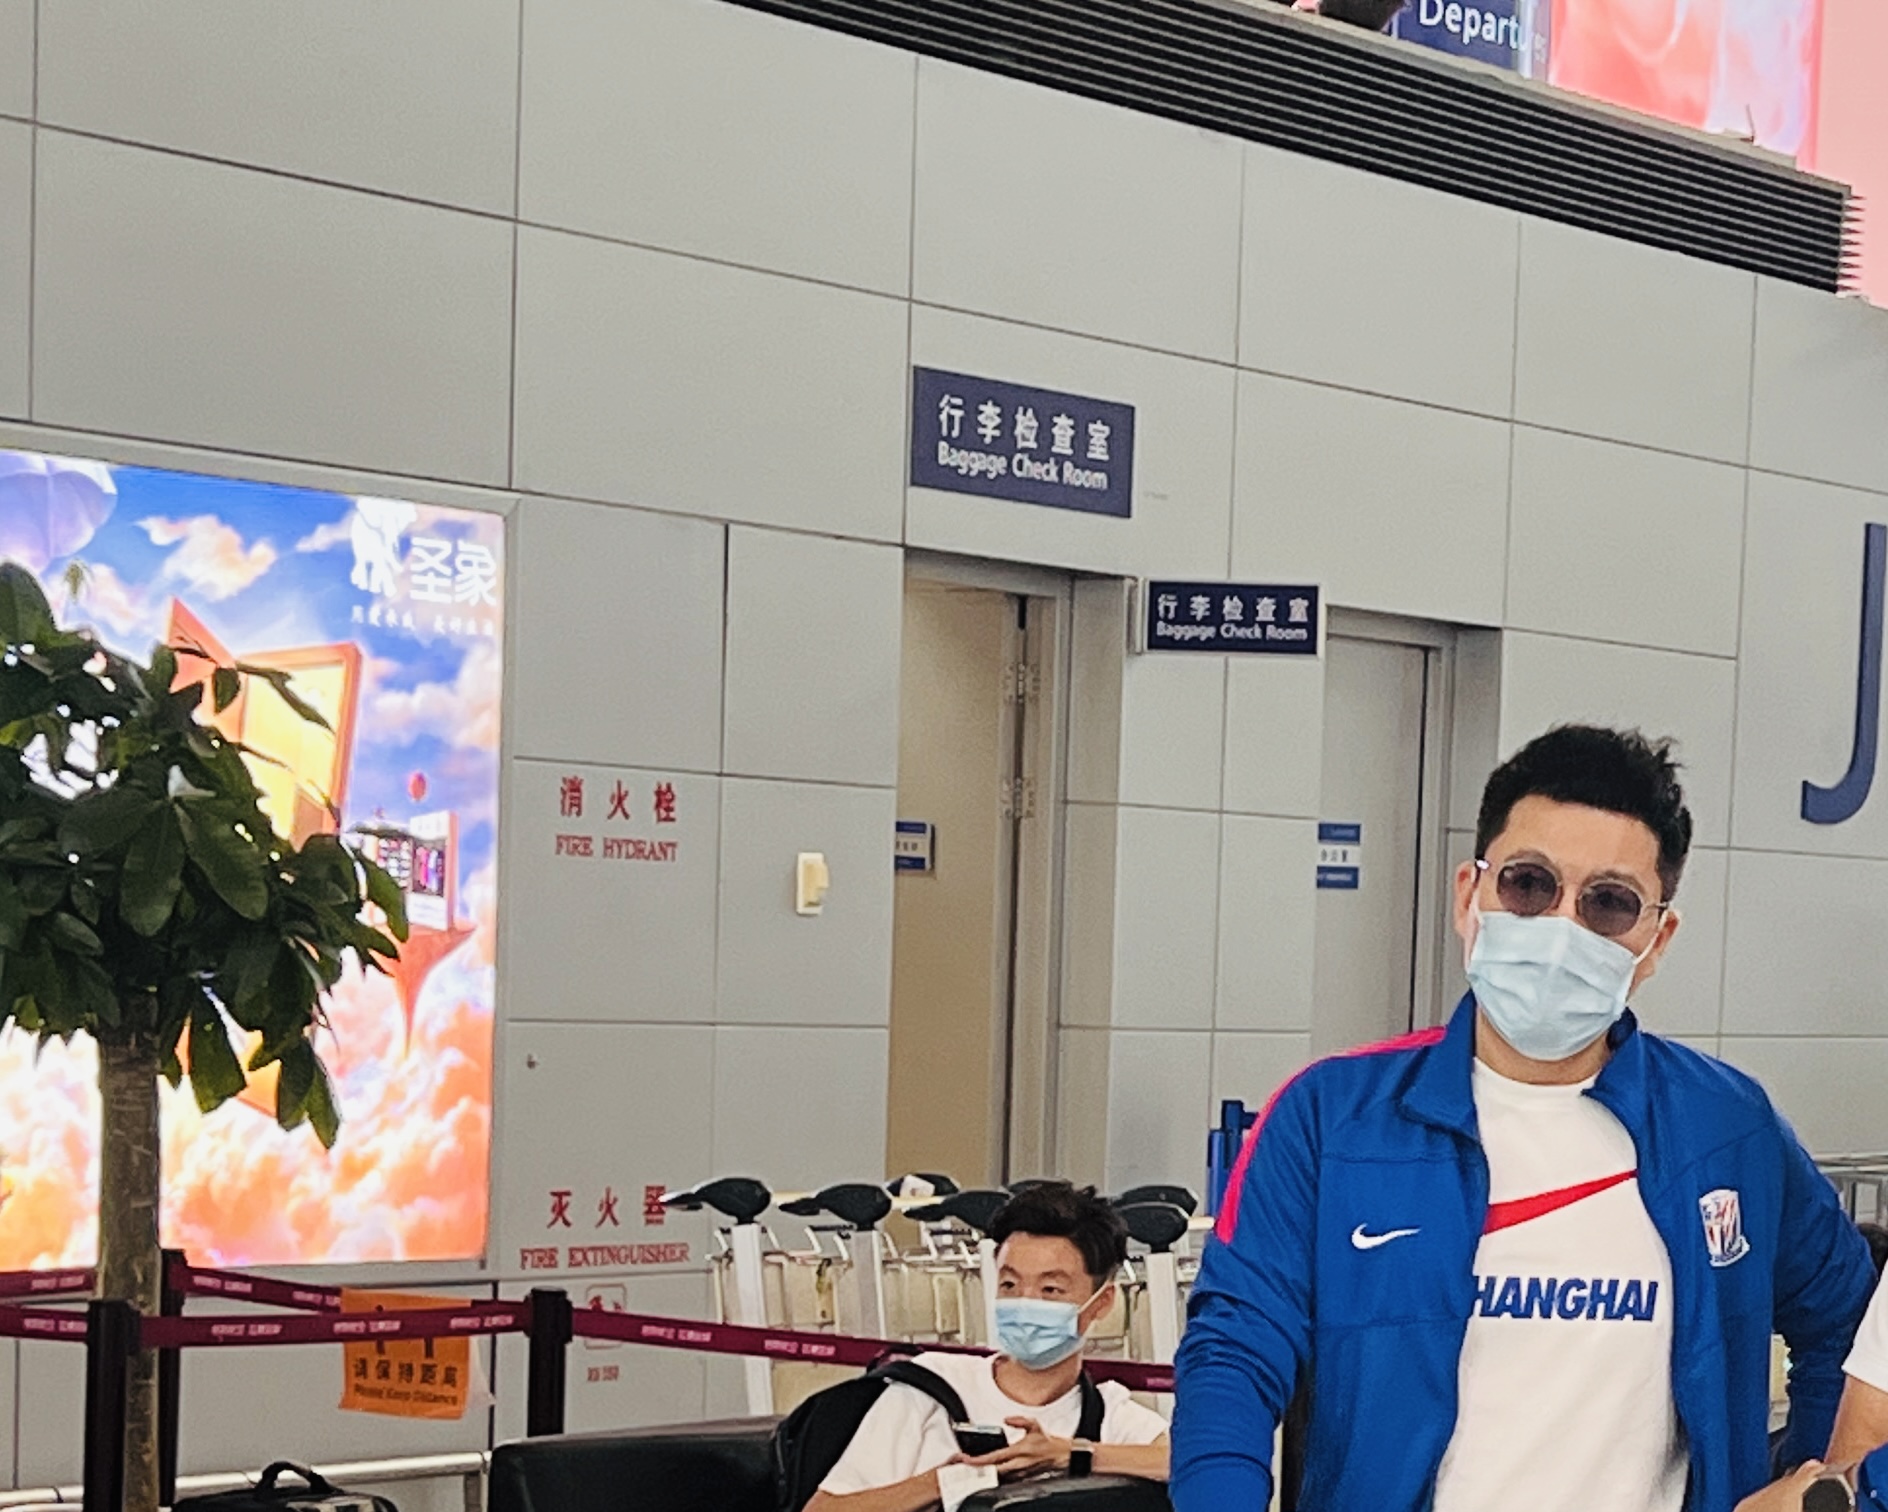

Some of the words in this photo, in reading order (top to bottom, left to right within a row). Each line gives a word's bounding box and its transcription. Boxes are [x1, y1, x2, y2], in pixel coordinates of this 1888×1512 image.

[939, 394, 1111, 462] 行李检查室
[938, 440, 1008, 480] Baggage
[1012, 452, 1059, 484] Check
[1062, 461, 1108, 491] Room
[409, 536, 498, 607] 圣象
[1156, 620, 1216, 642] Baggage
[1219, 622, 1263, 640] Check
[1266, 624, 1309, 641] Room
[1157, 593, 1310, 623] 行李检查室
[1800, 522, 1888, 825] J
[560, 774, 677, 824] 消火栓
[555, 834, 594, 858] FIRE
[602, 837, 677, 863] HYDRANT
[546, 1185, 667, 1229] 灭火器
[519, 1247, 559, 1270] FIRE
[567, 1242, 691, 1269] EXTINGUISHER
